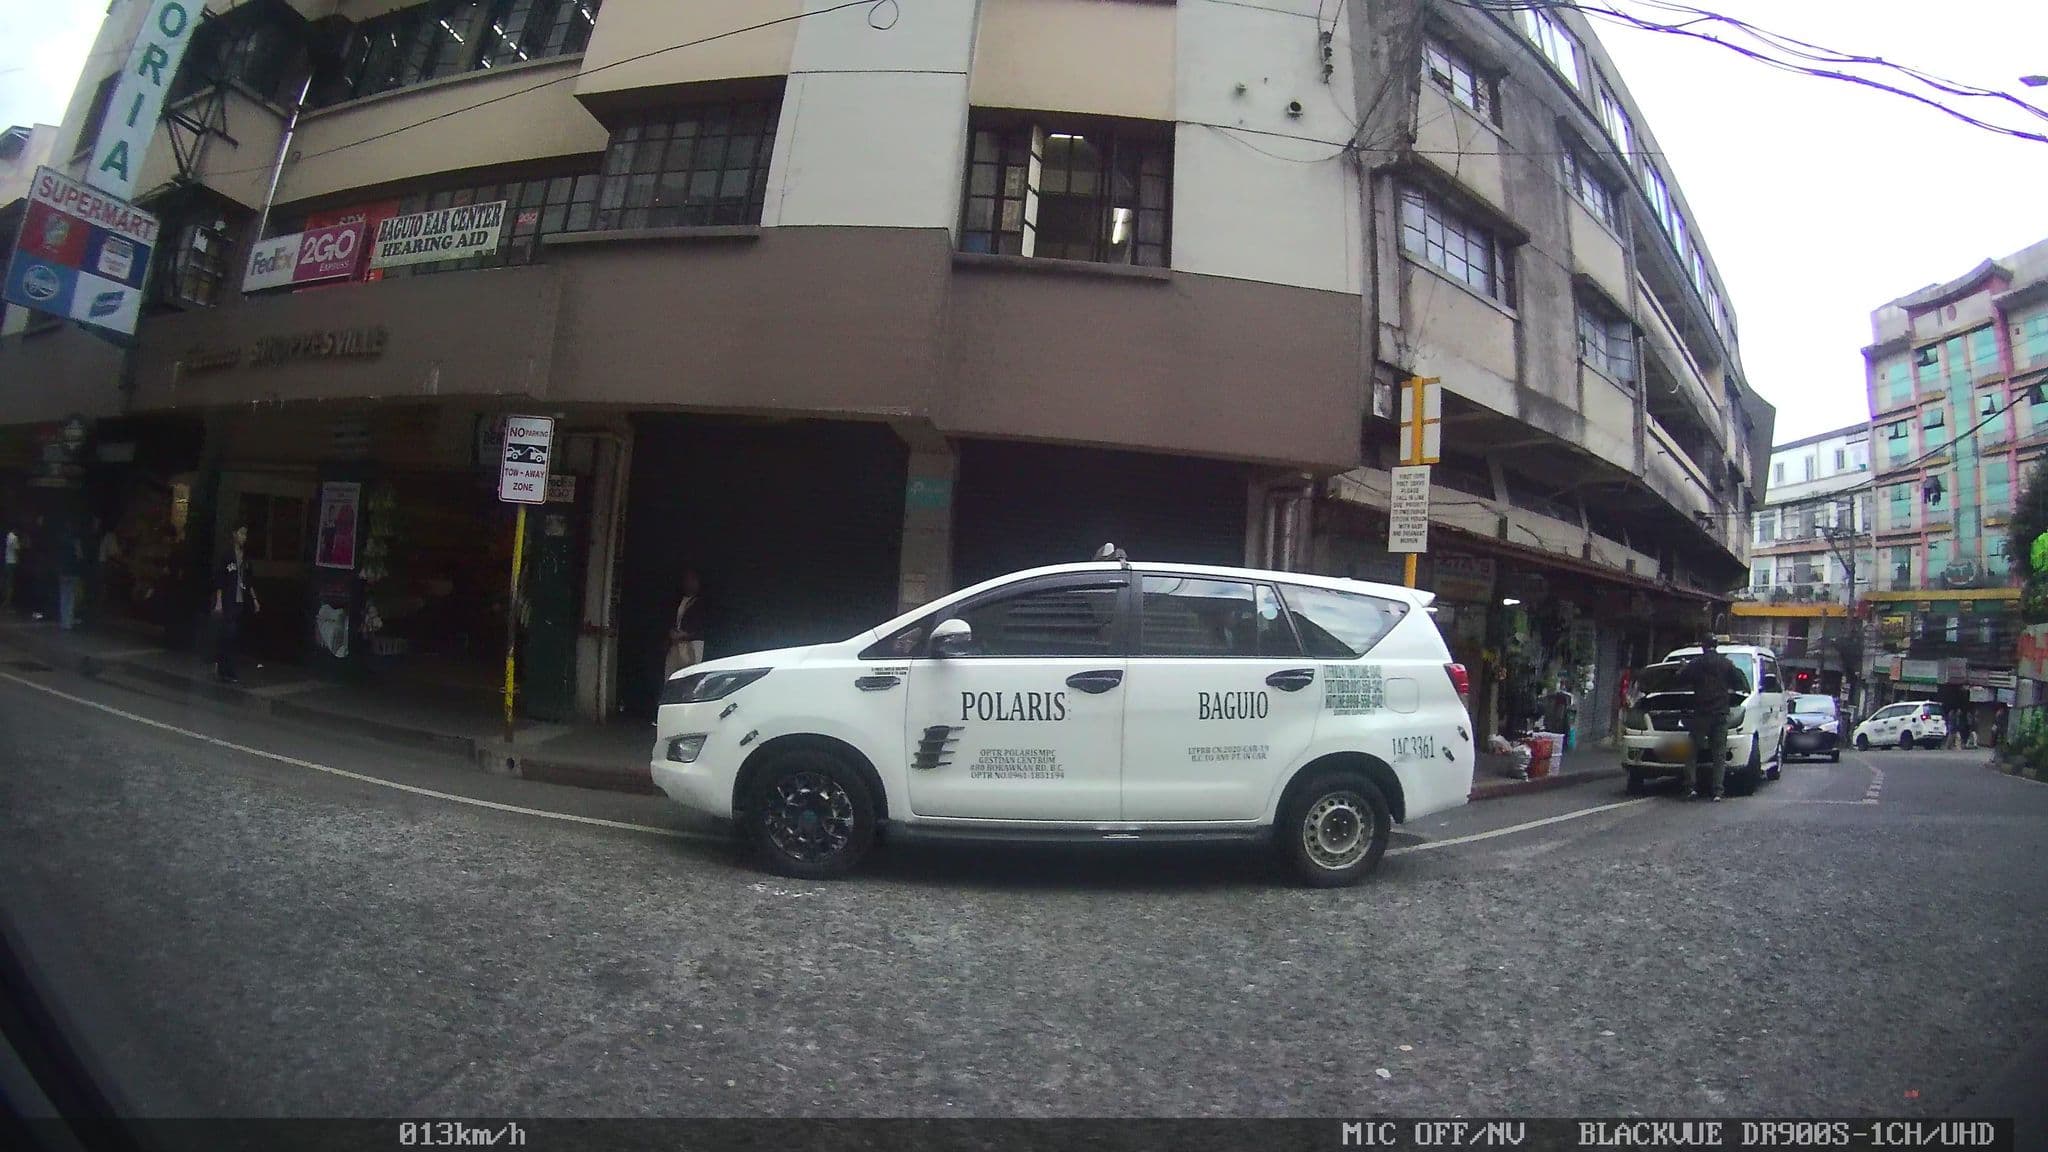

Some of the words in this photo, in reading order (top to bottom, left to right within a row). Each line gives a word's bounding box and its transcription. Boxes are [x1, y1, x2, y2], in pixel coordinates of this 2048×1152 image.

[38, 175, 156, 240] SUPERMART
[378, 214, 424, 242] BAGUIO
[424, 209, 450, 236] EAR
[450, 203, 503, 231] CENTER
[300, 229, 356, 265] 2GO
[381, 234, 454, 258] HEARING
[456, 230, 489, 249] AID
[250, 246, 294, 276] FedEx
[509, 428, 525, 438] NO
[525, 430, 549, 438] PARKING
[505, 468, 519, 476] TOW
[524, 471, 545, 479] AWAY
[512, 482, 534, 492] ZONE
[961, 692, 1066, 721] POLARIS
[1198, 691, 1269, 720] BAGUIO
[1411, 735, 1435, 758] 3361
